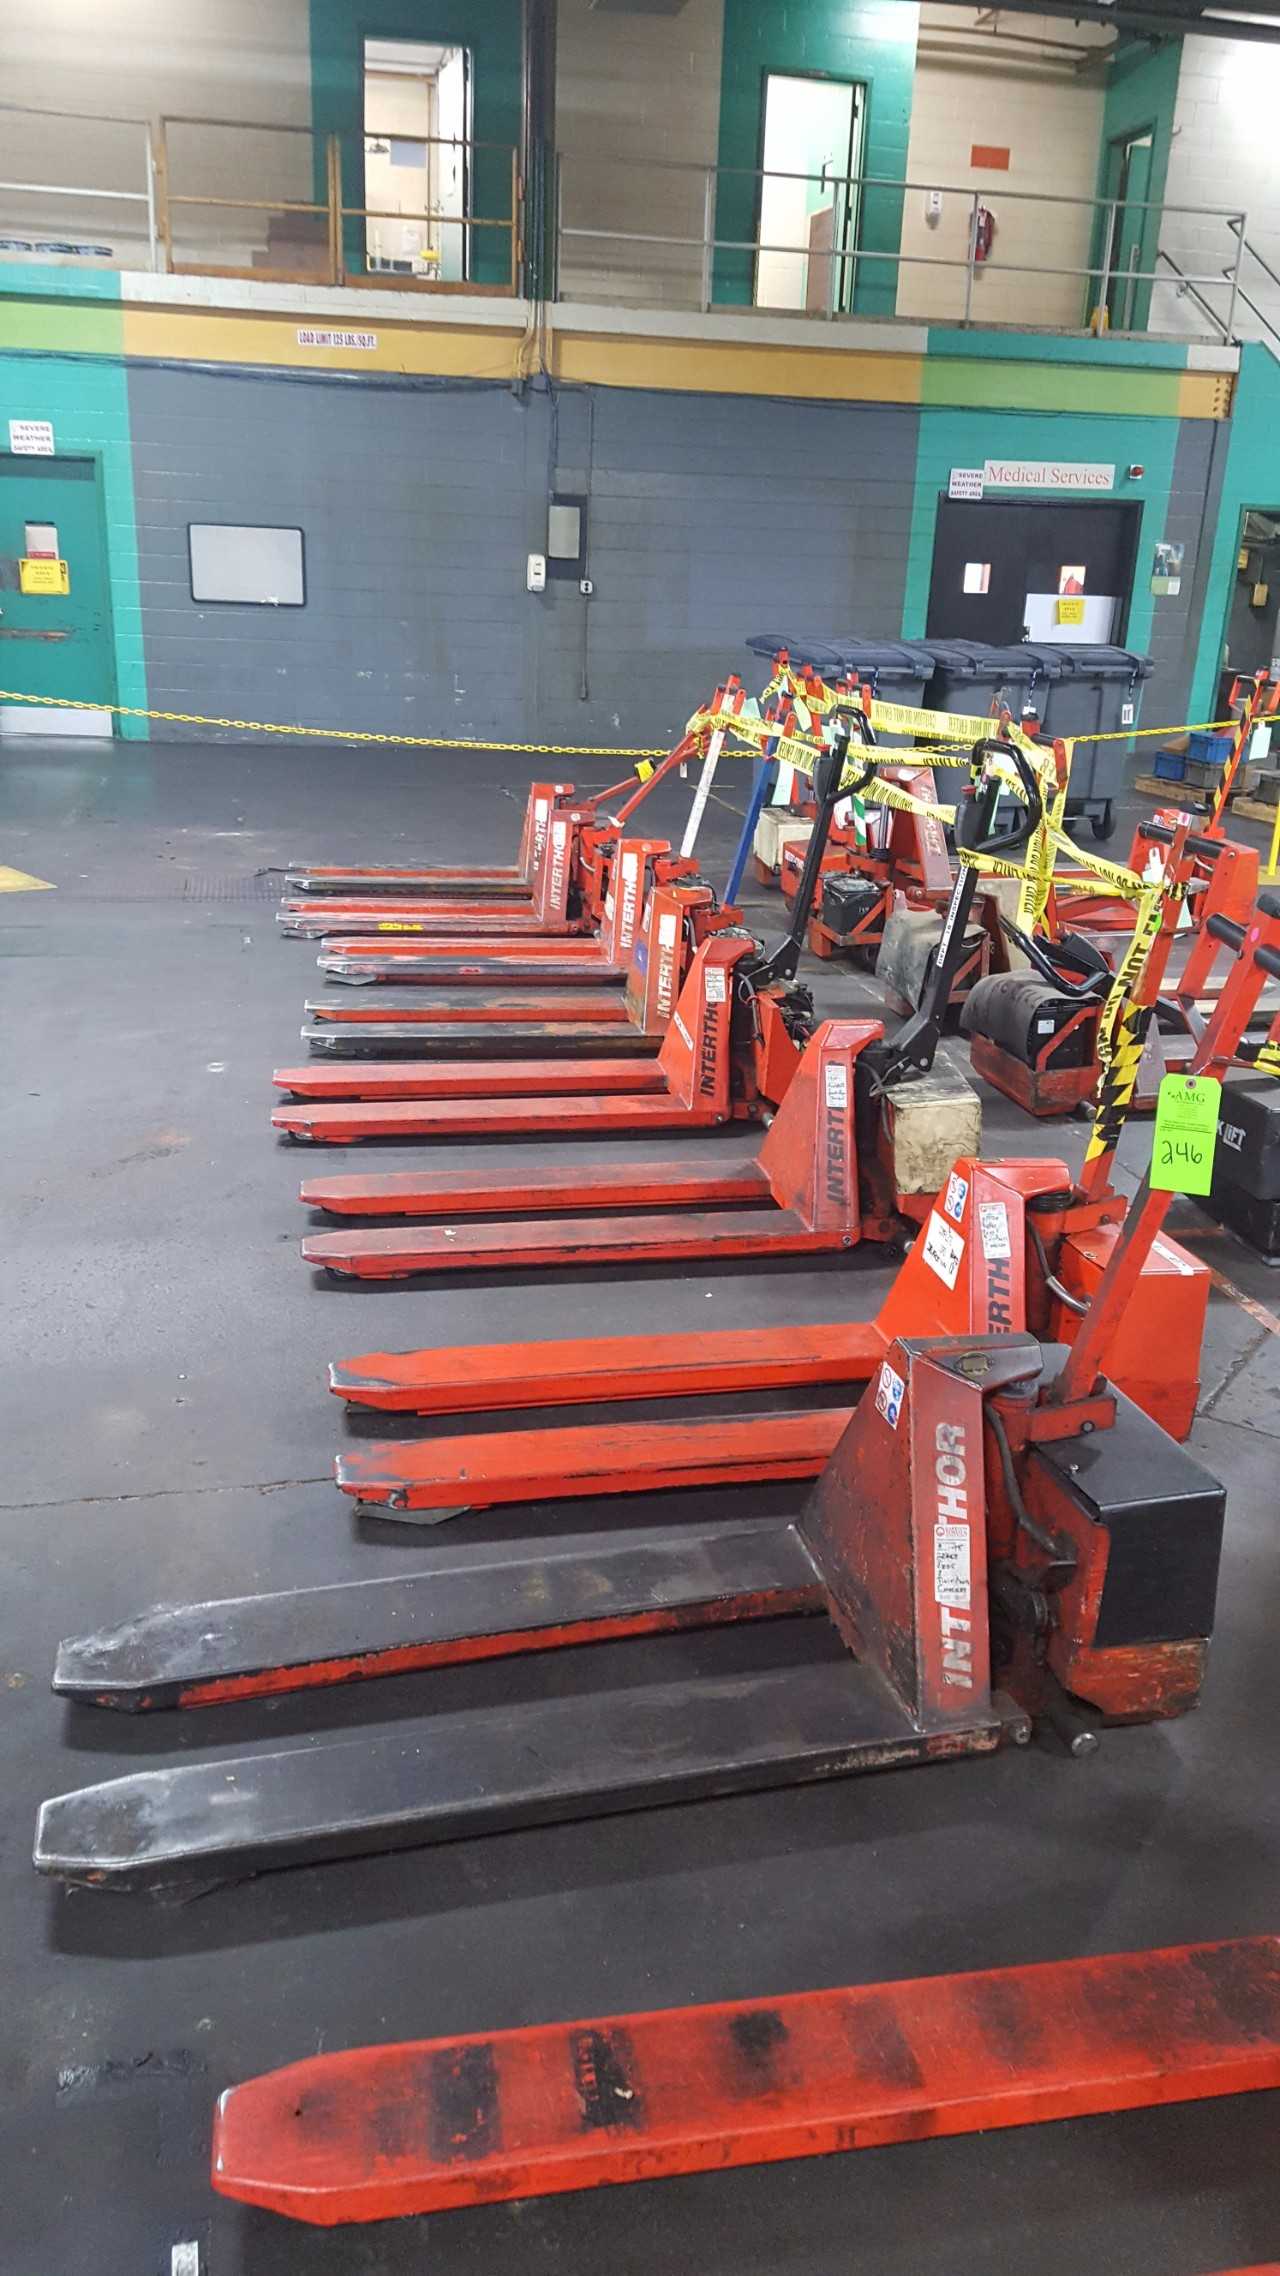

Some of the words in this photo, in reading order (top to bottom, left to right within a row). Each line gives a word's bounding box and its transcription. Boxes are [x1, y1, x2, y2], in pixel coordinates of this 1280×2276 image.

[988, 466, 1046, 483] Medical
[1051, 468, 1110, 487] Services
[1161, 1140, 1203, 1166] 246
